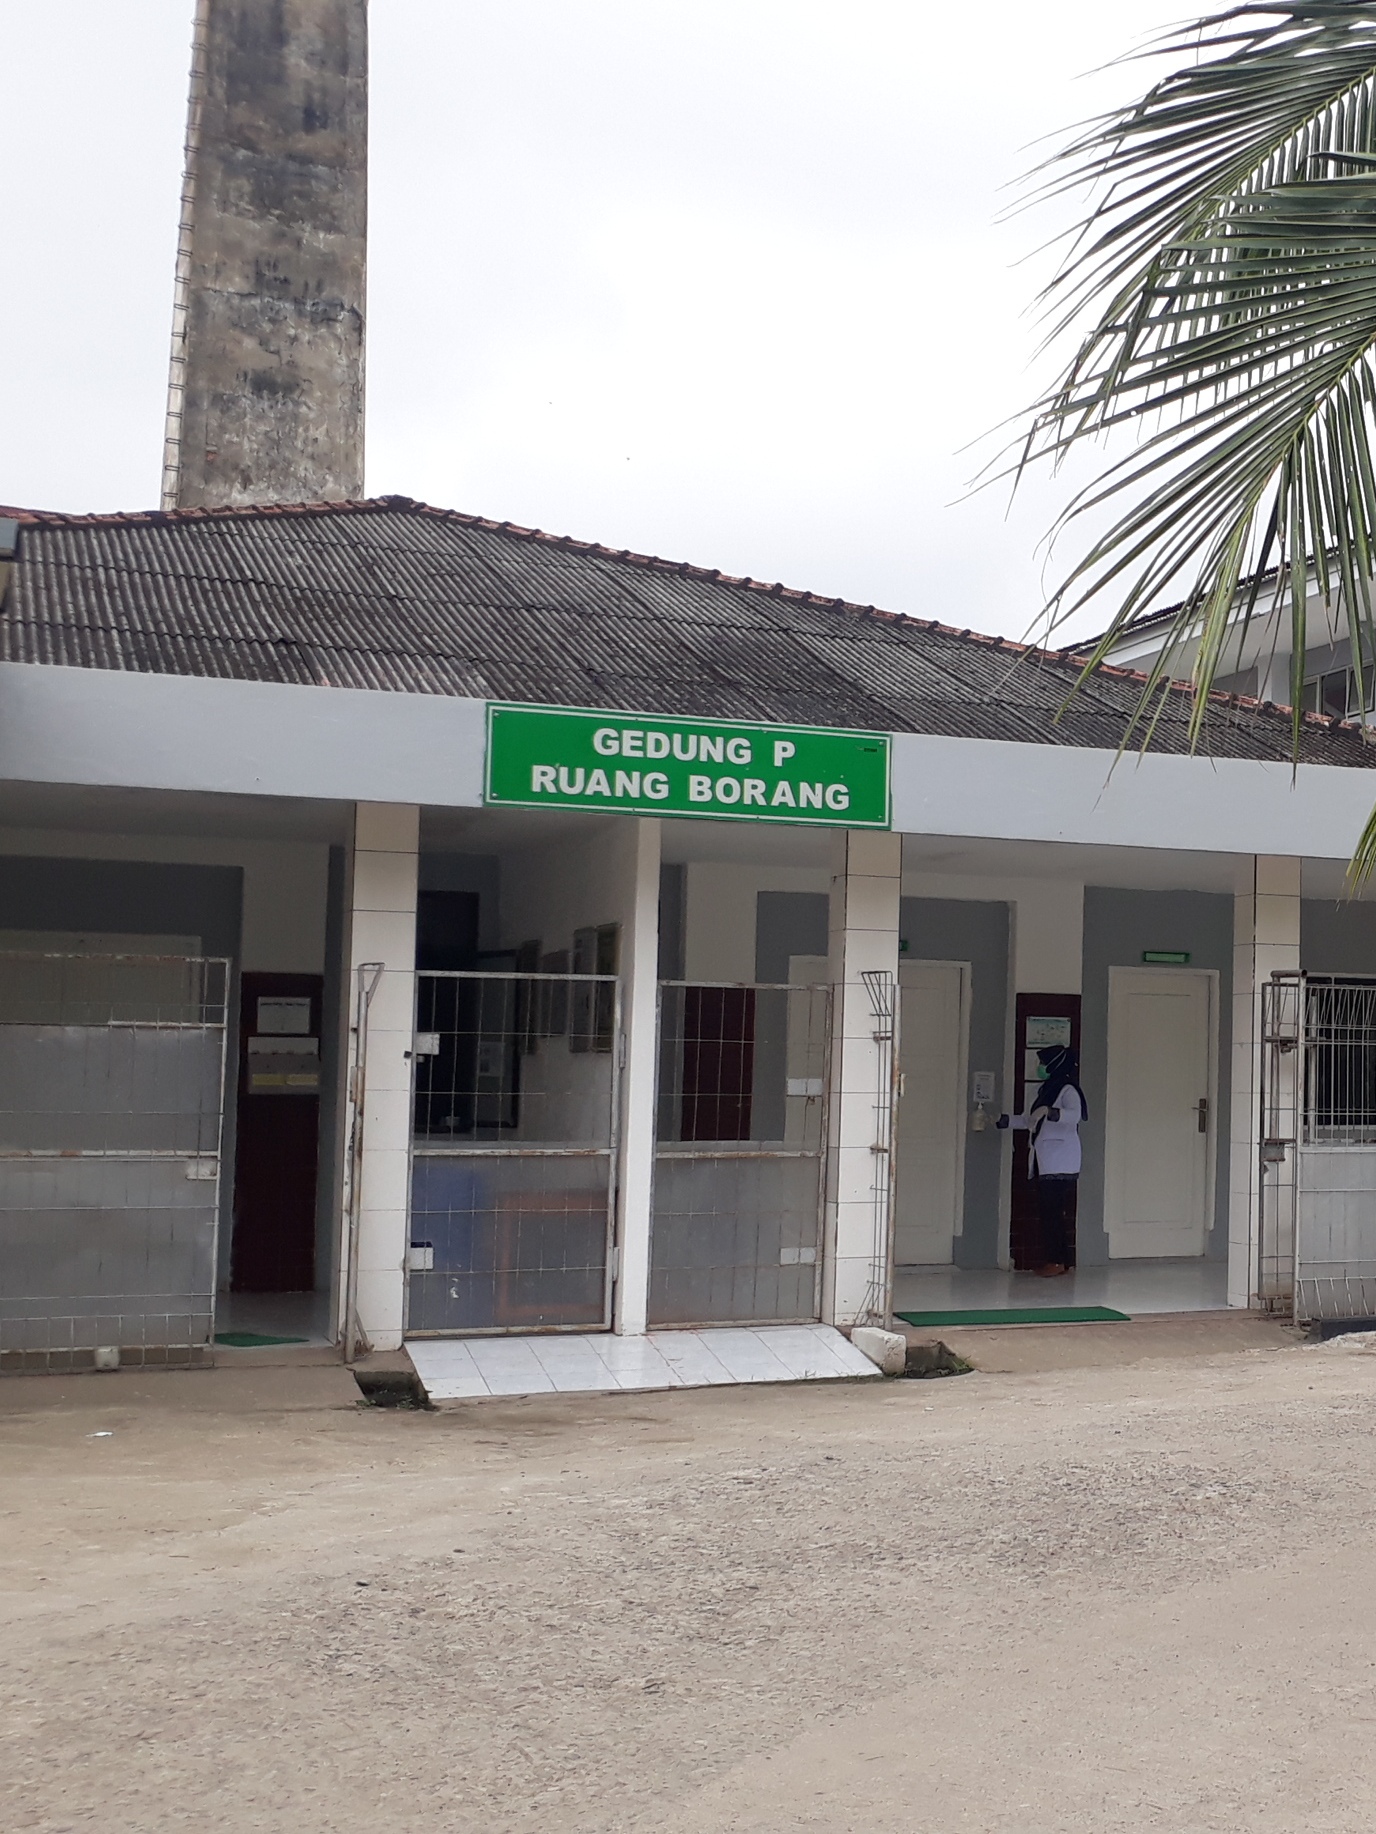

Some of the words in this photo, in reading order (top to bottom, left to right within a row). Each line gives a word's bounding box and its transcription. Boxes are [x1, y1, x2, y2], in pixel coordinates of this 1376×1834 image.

[593, 728, 752, 765] GEDUNG
[773, 741, 796, 767] P
[530, 764, 669, 800] RUANG
[689, 775, 850, 810] BORANG
